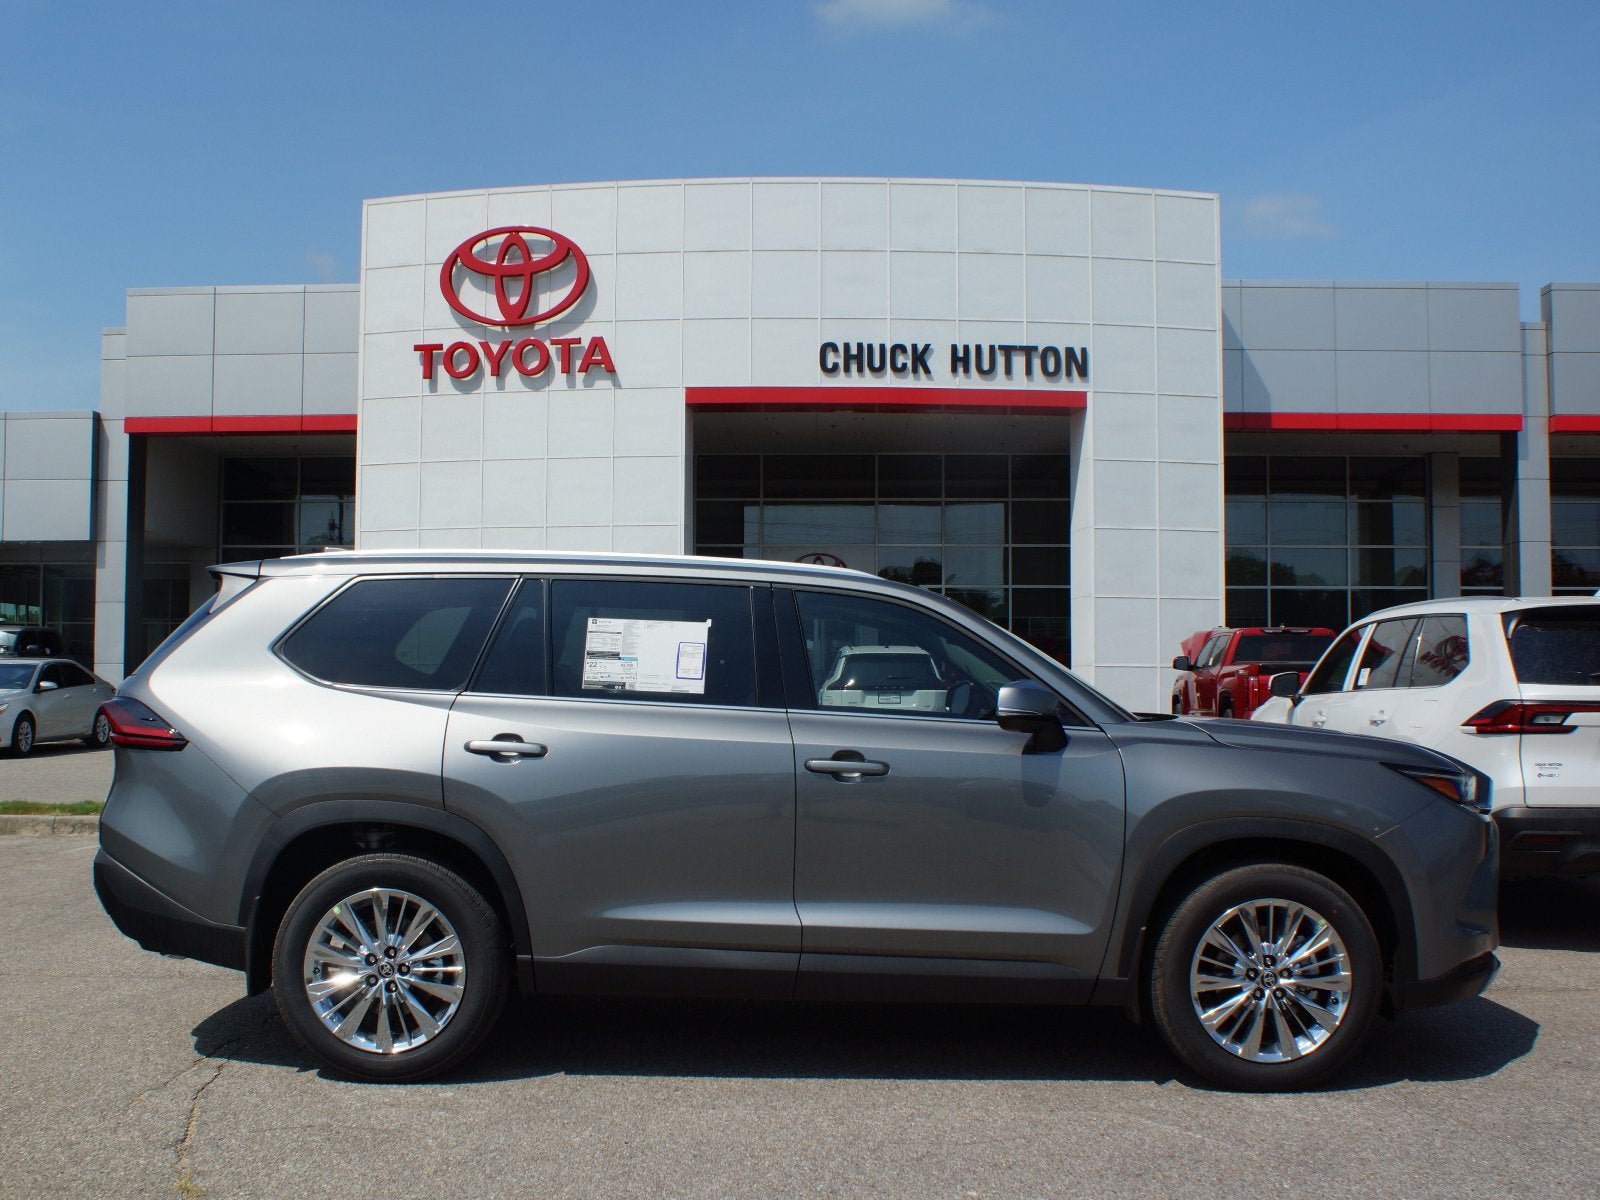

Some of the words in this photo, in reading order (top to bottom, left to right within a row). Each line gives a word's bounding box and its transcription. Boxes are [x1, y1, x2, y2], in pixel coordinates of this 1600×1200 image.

[414, 336, 616, 379] TOYOTA
[819, 342, 931, 375] CHUCK
[950, 344, 1088, 377] HUTTON
